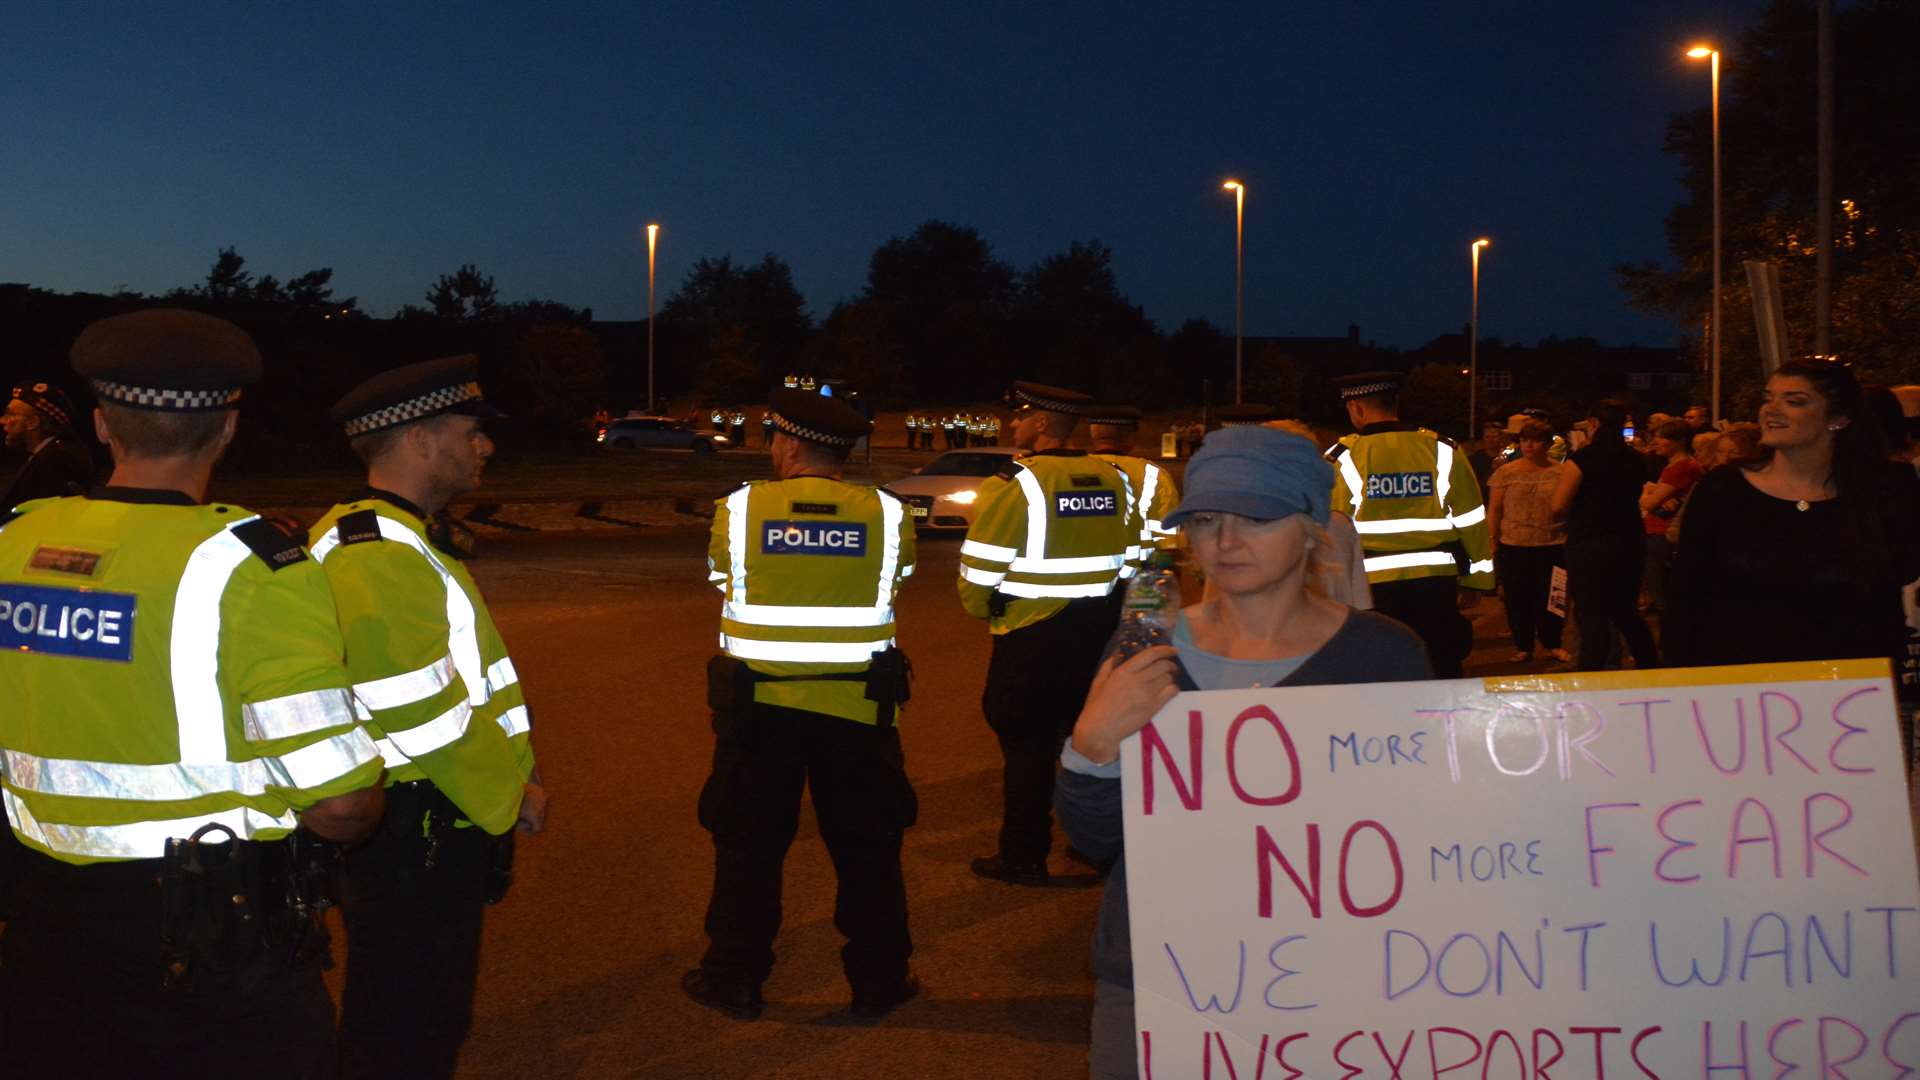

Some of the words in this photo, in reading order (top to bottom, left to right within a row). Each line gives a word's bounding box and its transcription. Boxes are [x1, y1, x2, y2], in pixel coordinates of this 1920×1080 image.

[1059, 496, 1115, 512] POLICE
[1368, 474, 1433, 496] POLICE
[767, 528, 860, 549] POLICE
[1140, 704, 1302, 815] NO
[1329, 731, 1429, 772] MORE
[1416, 686, 1881, 783] TORTURE
[1256, 820, 1404, 918] NO
[1430, 840, 1544, 882] MORE
[1585, 792, 1870, 888] FEAR
[1164, 934, 1319, 1014] WE
[1385, 917, 1606, 1000] DON'T
[1650, 908, 1917, 988] WANT
